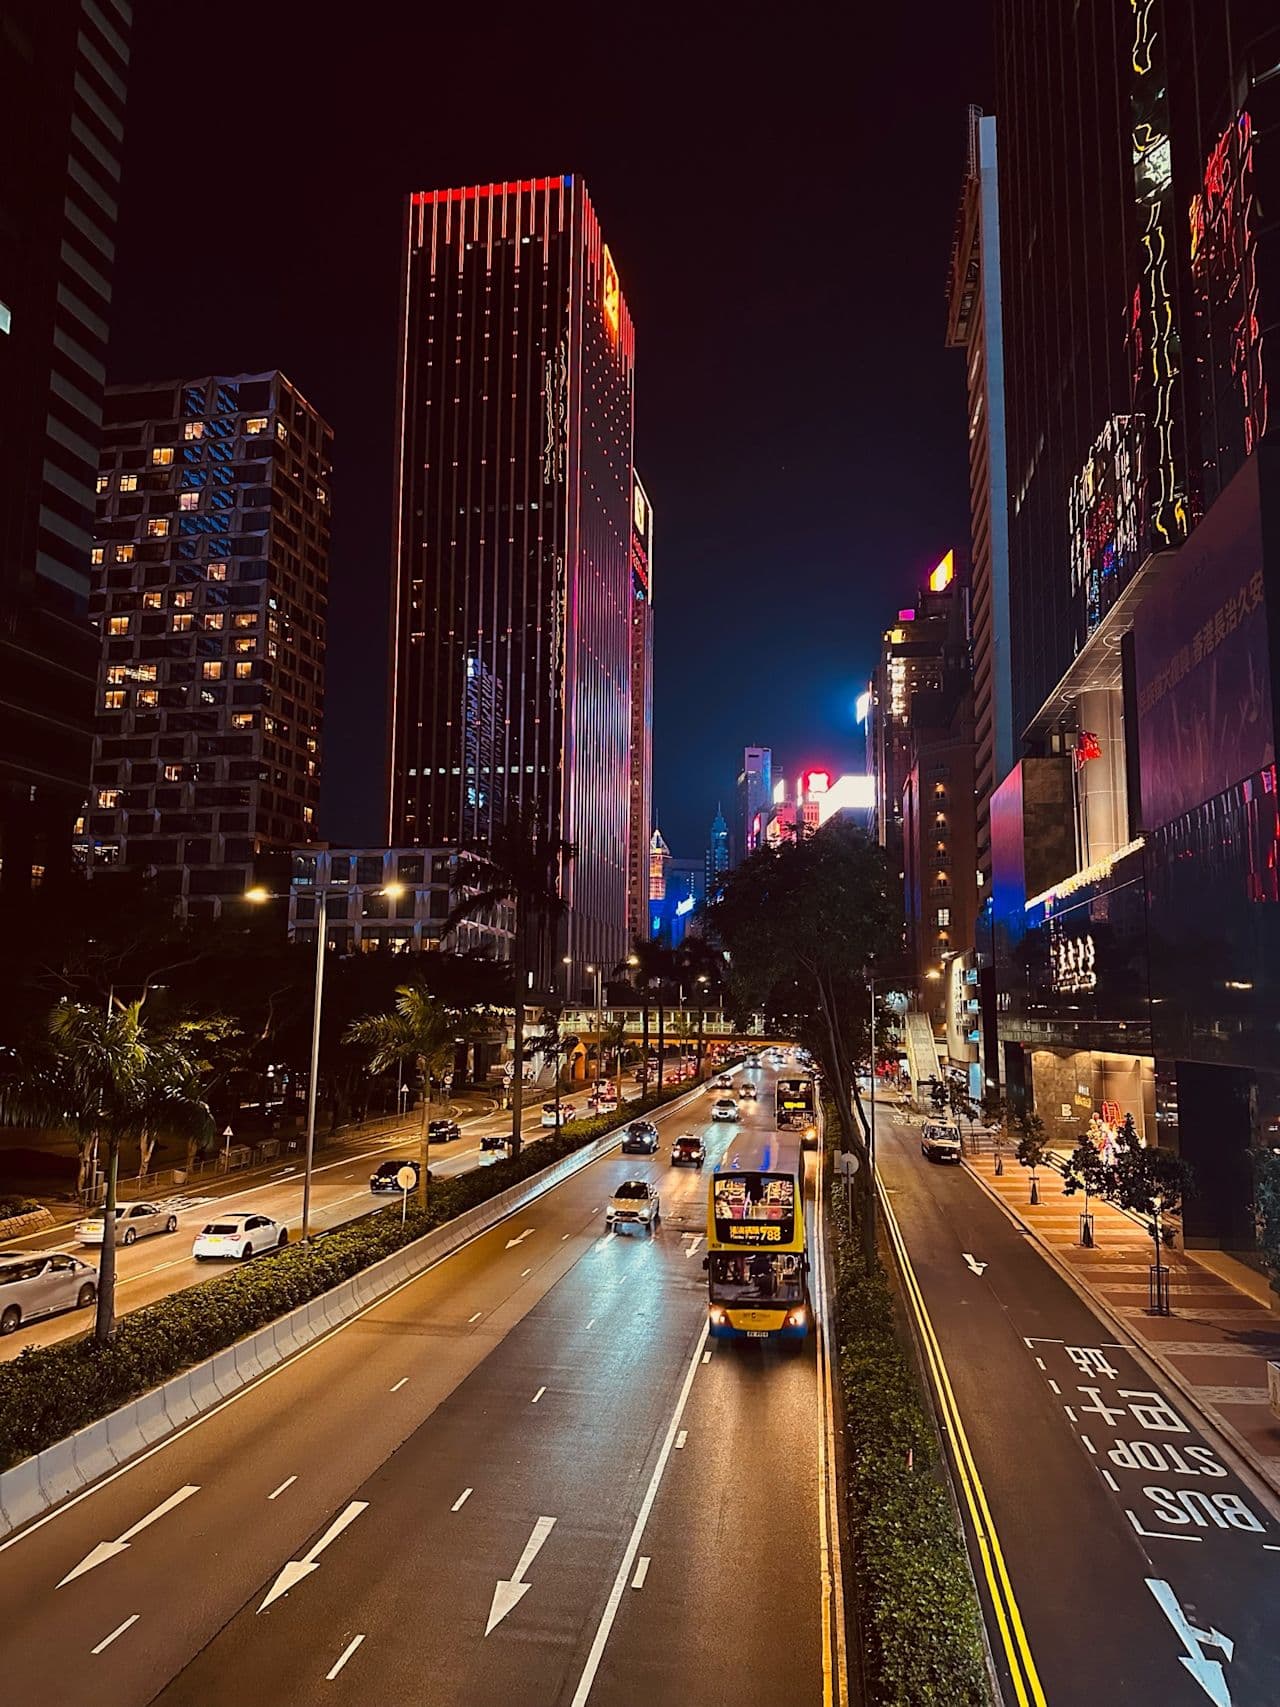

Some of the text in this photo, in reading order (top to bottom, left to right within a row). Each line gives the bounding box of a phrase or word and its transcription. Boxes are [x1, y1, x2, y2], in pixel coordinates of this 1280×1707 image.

[760, 1230, 782, 1241] 788
[1064, 1346, 1118, 1380] 站
[1077, 1386, 1190, 1433] 巴士
[1108, 1439, 1228, 1477] STOP
[1143, 1486, 1267, 1532] BUS
